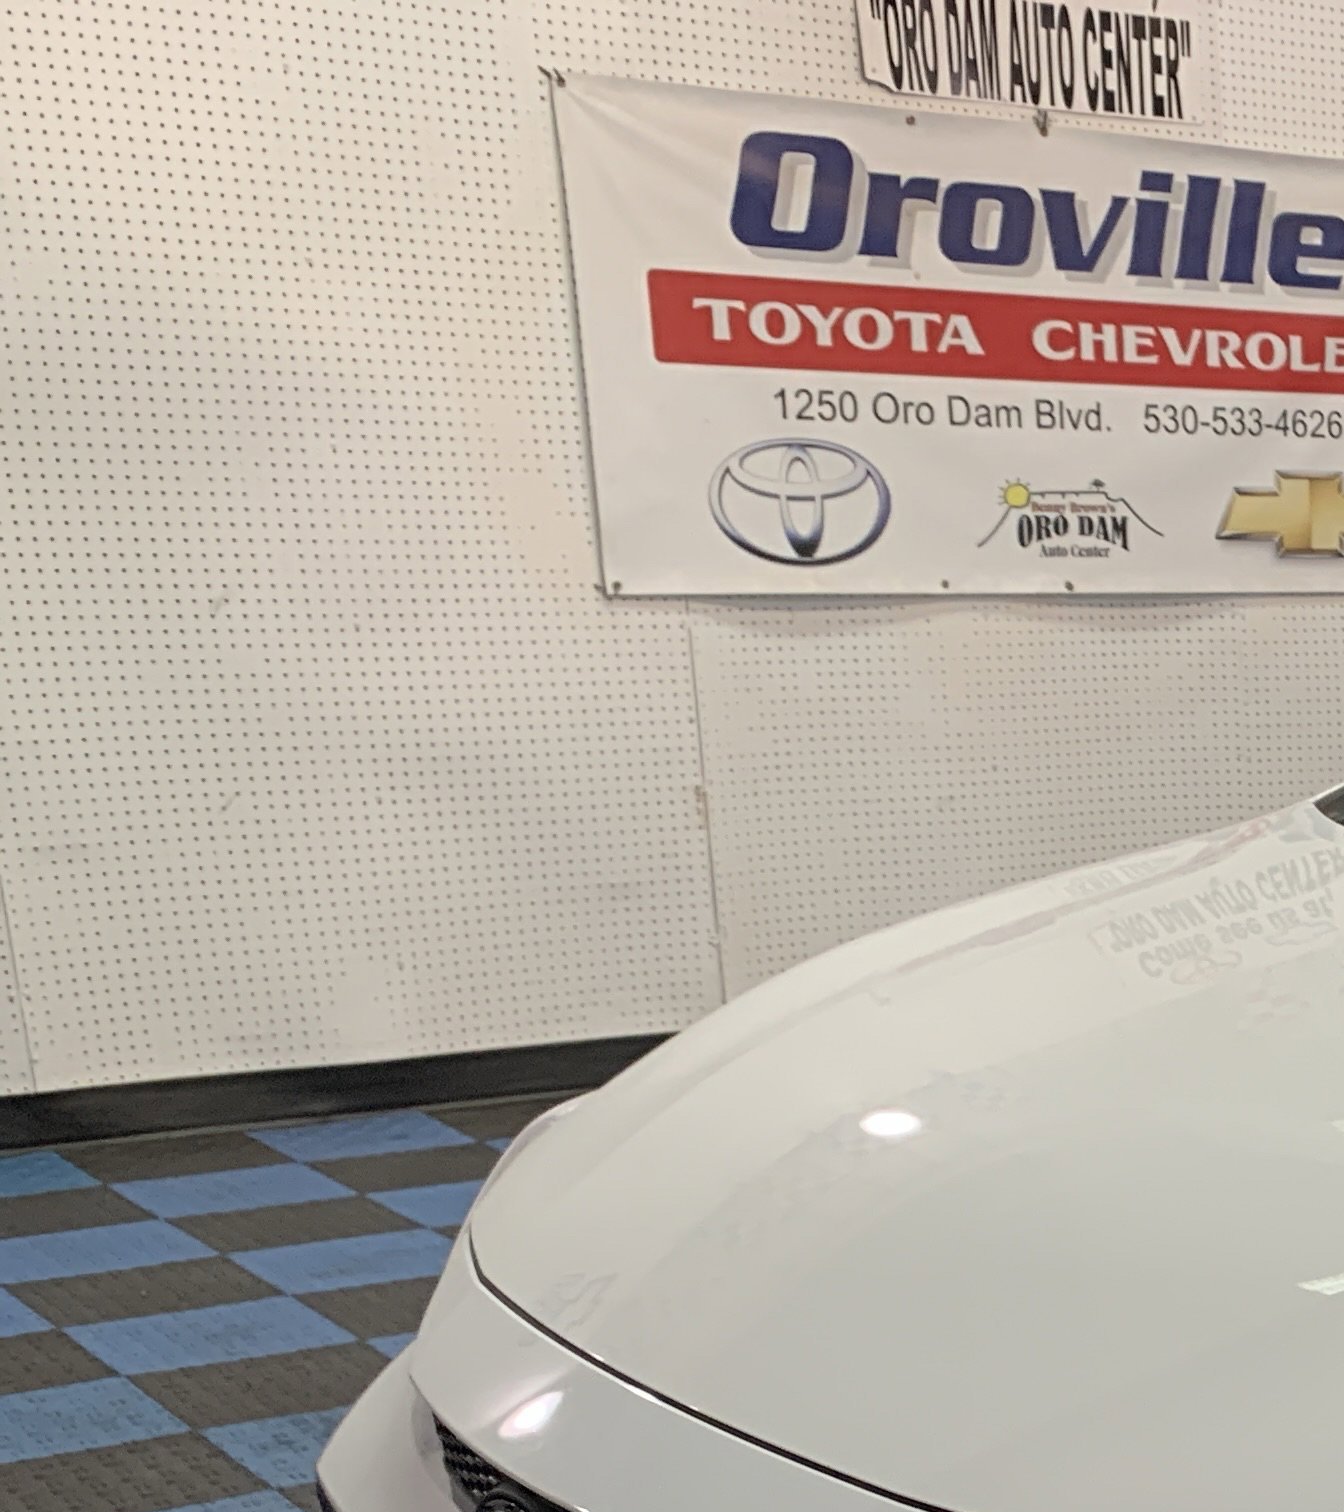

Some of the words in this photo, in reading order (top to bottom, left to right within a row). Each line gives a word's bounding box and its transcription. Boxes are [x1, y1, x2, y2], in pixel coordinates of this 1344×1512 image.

[946, 0, 1001, 101] DAM
[1010, 0, 1075, 110] AUTO
[1083, 7, 1191, 120] CENTER"
[692, 297, 986, 356] TOYOTA
[773, 388, 859, 422] 1250
[871, 391, 935, 426] Oro
[946, 394, 1023, 428] Dam
[1035, 398, 1112, 432] Blvd.
[1143, 402, 1344, 440] 530-533-4626
[1018, 514, 1069, 548] ORO
[1077, 515, 1130, 551] DAM
